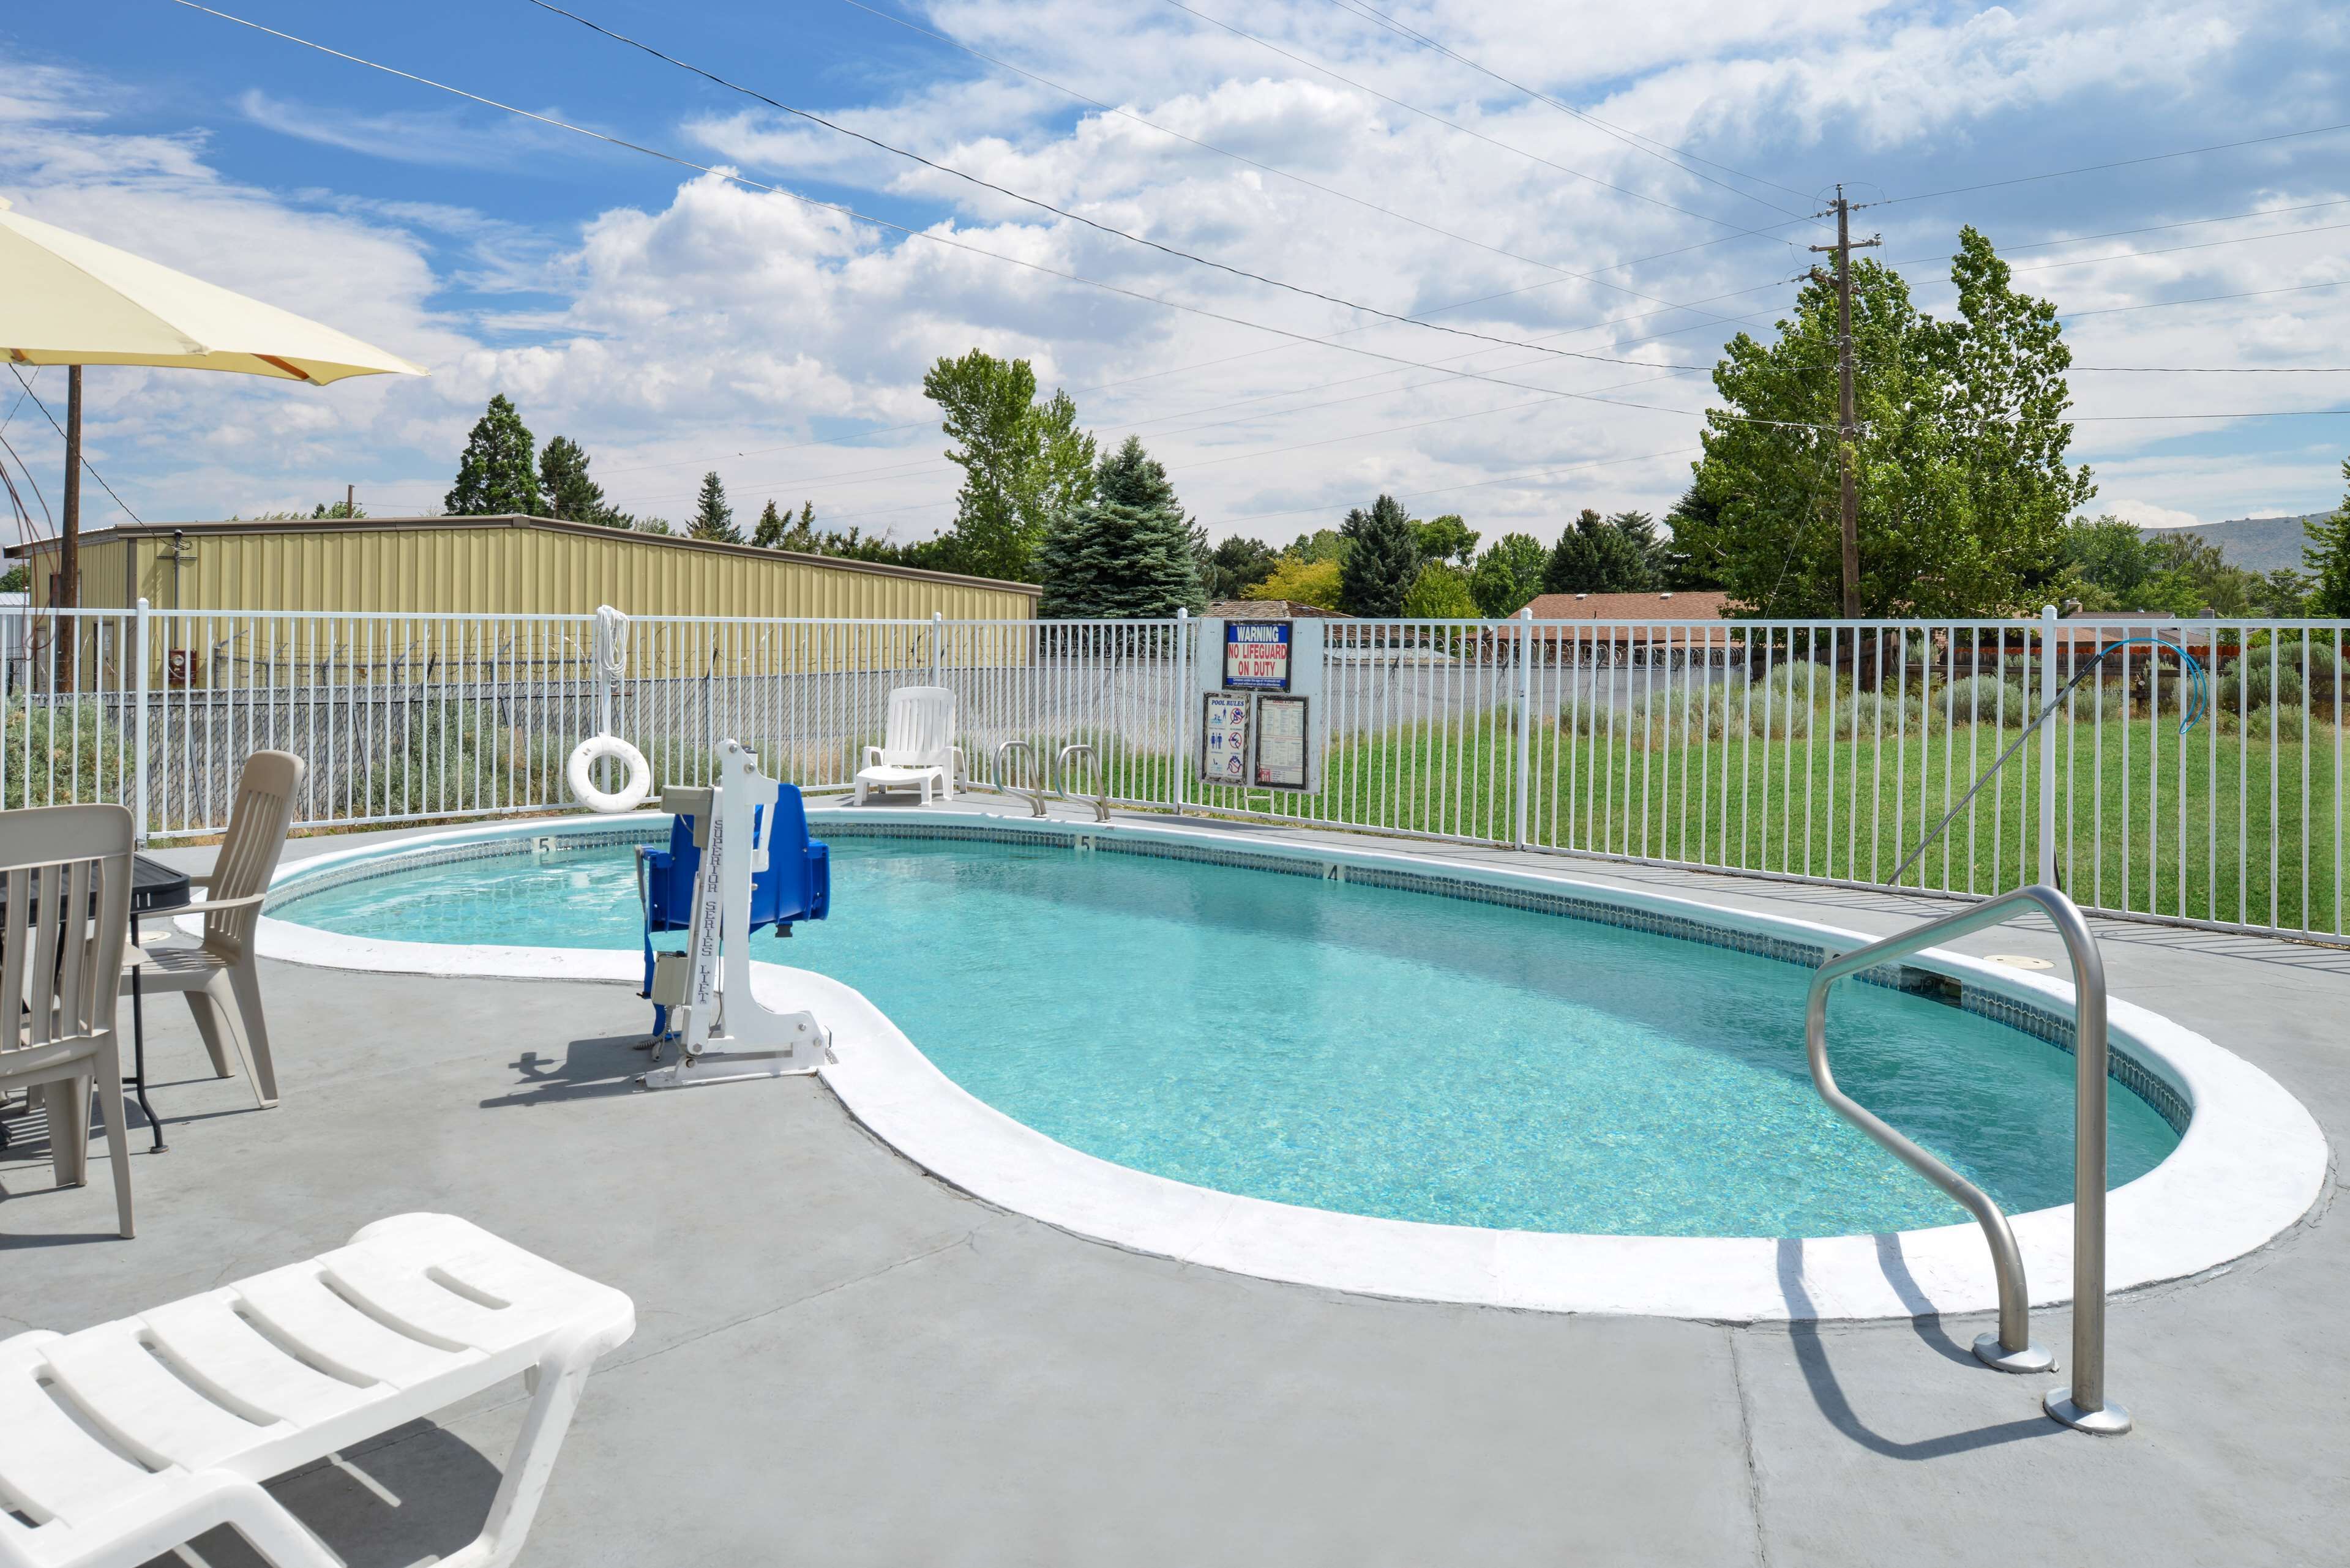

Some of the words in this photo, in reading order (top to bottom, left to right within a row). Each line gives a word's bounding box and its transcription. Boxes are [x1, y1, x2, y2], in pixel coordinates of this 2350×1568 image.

[1237, 626, 1279, 642] WARNING
[1229, 644, 1239, 659] NO
[1243, 644, 1287, 660] LIFEGUARD
[1238, 660, 1249, 676] ON
[1254, 661, 1276, 676] DUTY
[539, 837, 550, 852] 5
[707, 819, 723, 892] SUPERIOR
[702, 901, 716, 956] SERIES
